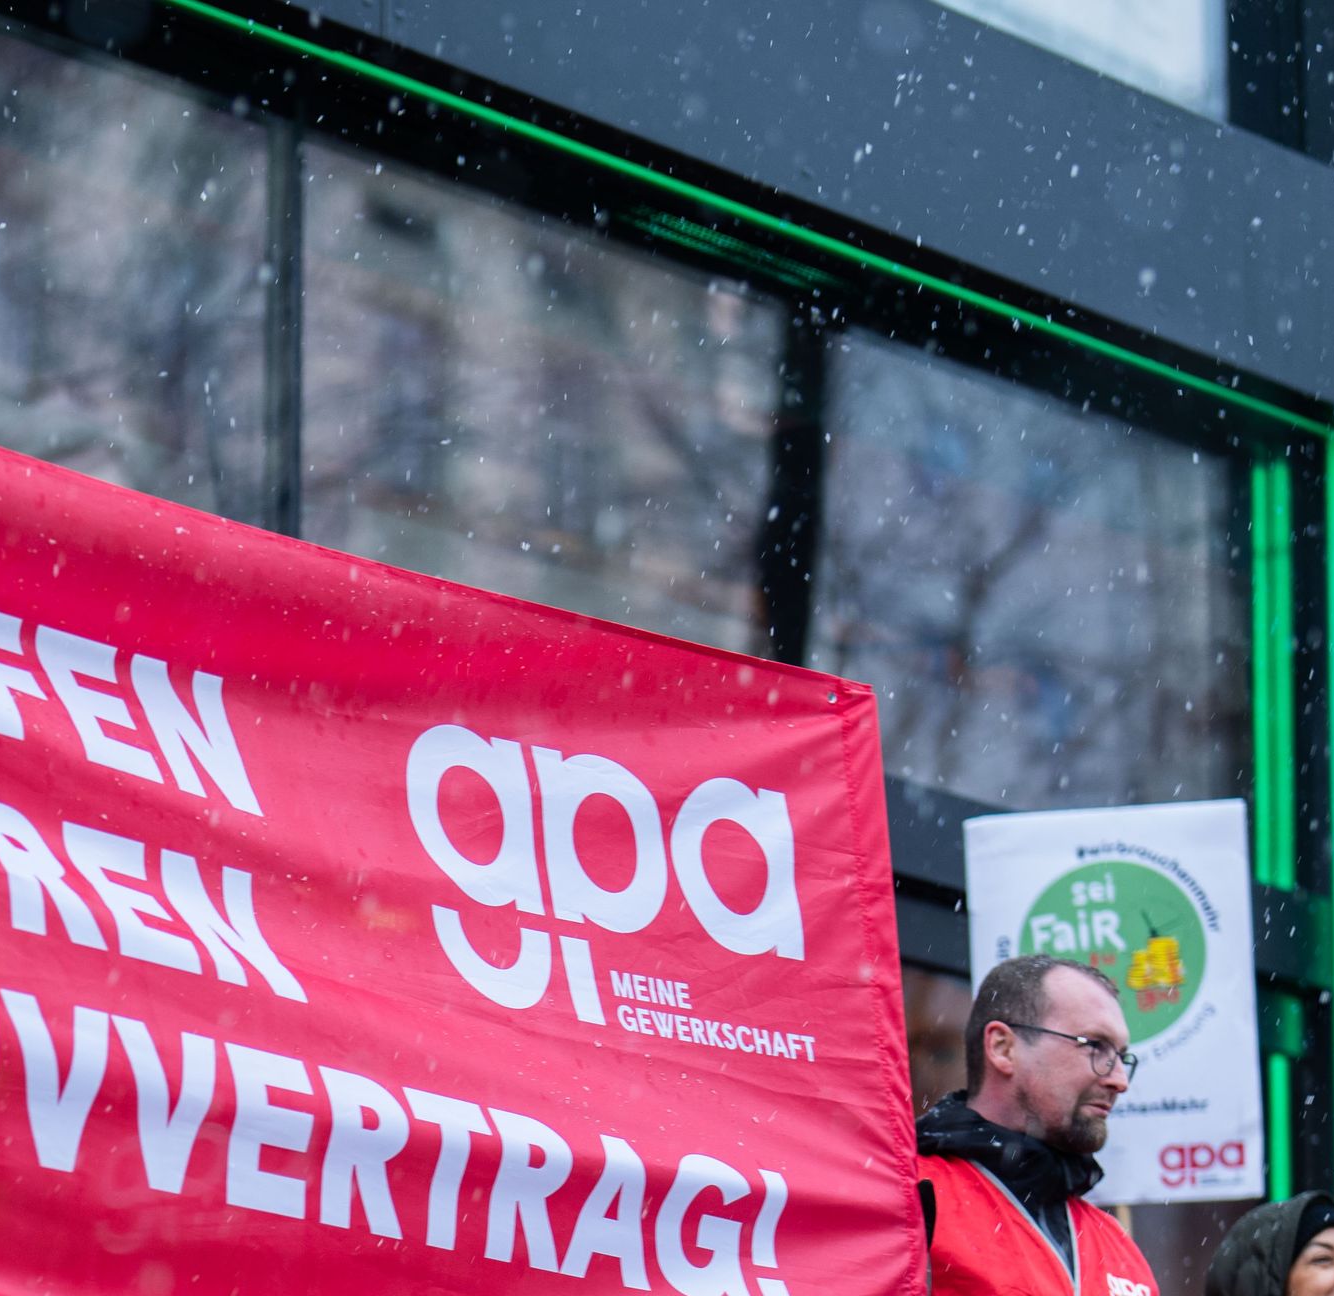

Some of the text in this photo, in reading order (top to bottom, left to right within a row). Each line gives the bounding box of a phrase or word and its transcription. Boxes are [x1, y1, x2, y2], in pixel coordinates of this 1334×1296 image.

[405, 723, 806, 1027] gpa
[1070, 872, 1116, 906] sei
[610, 969, 693, 1010] MEINE
[616, 1006, 816, 1063] GEWERKSCHAFT
[1159, 1141, 1246, 1187] gpa
